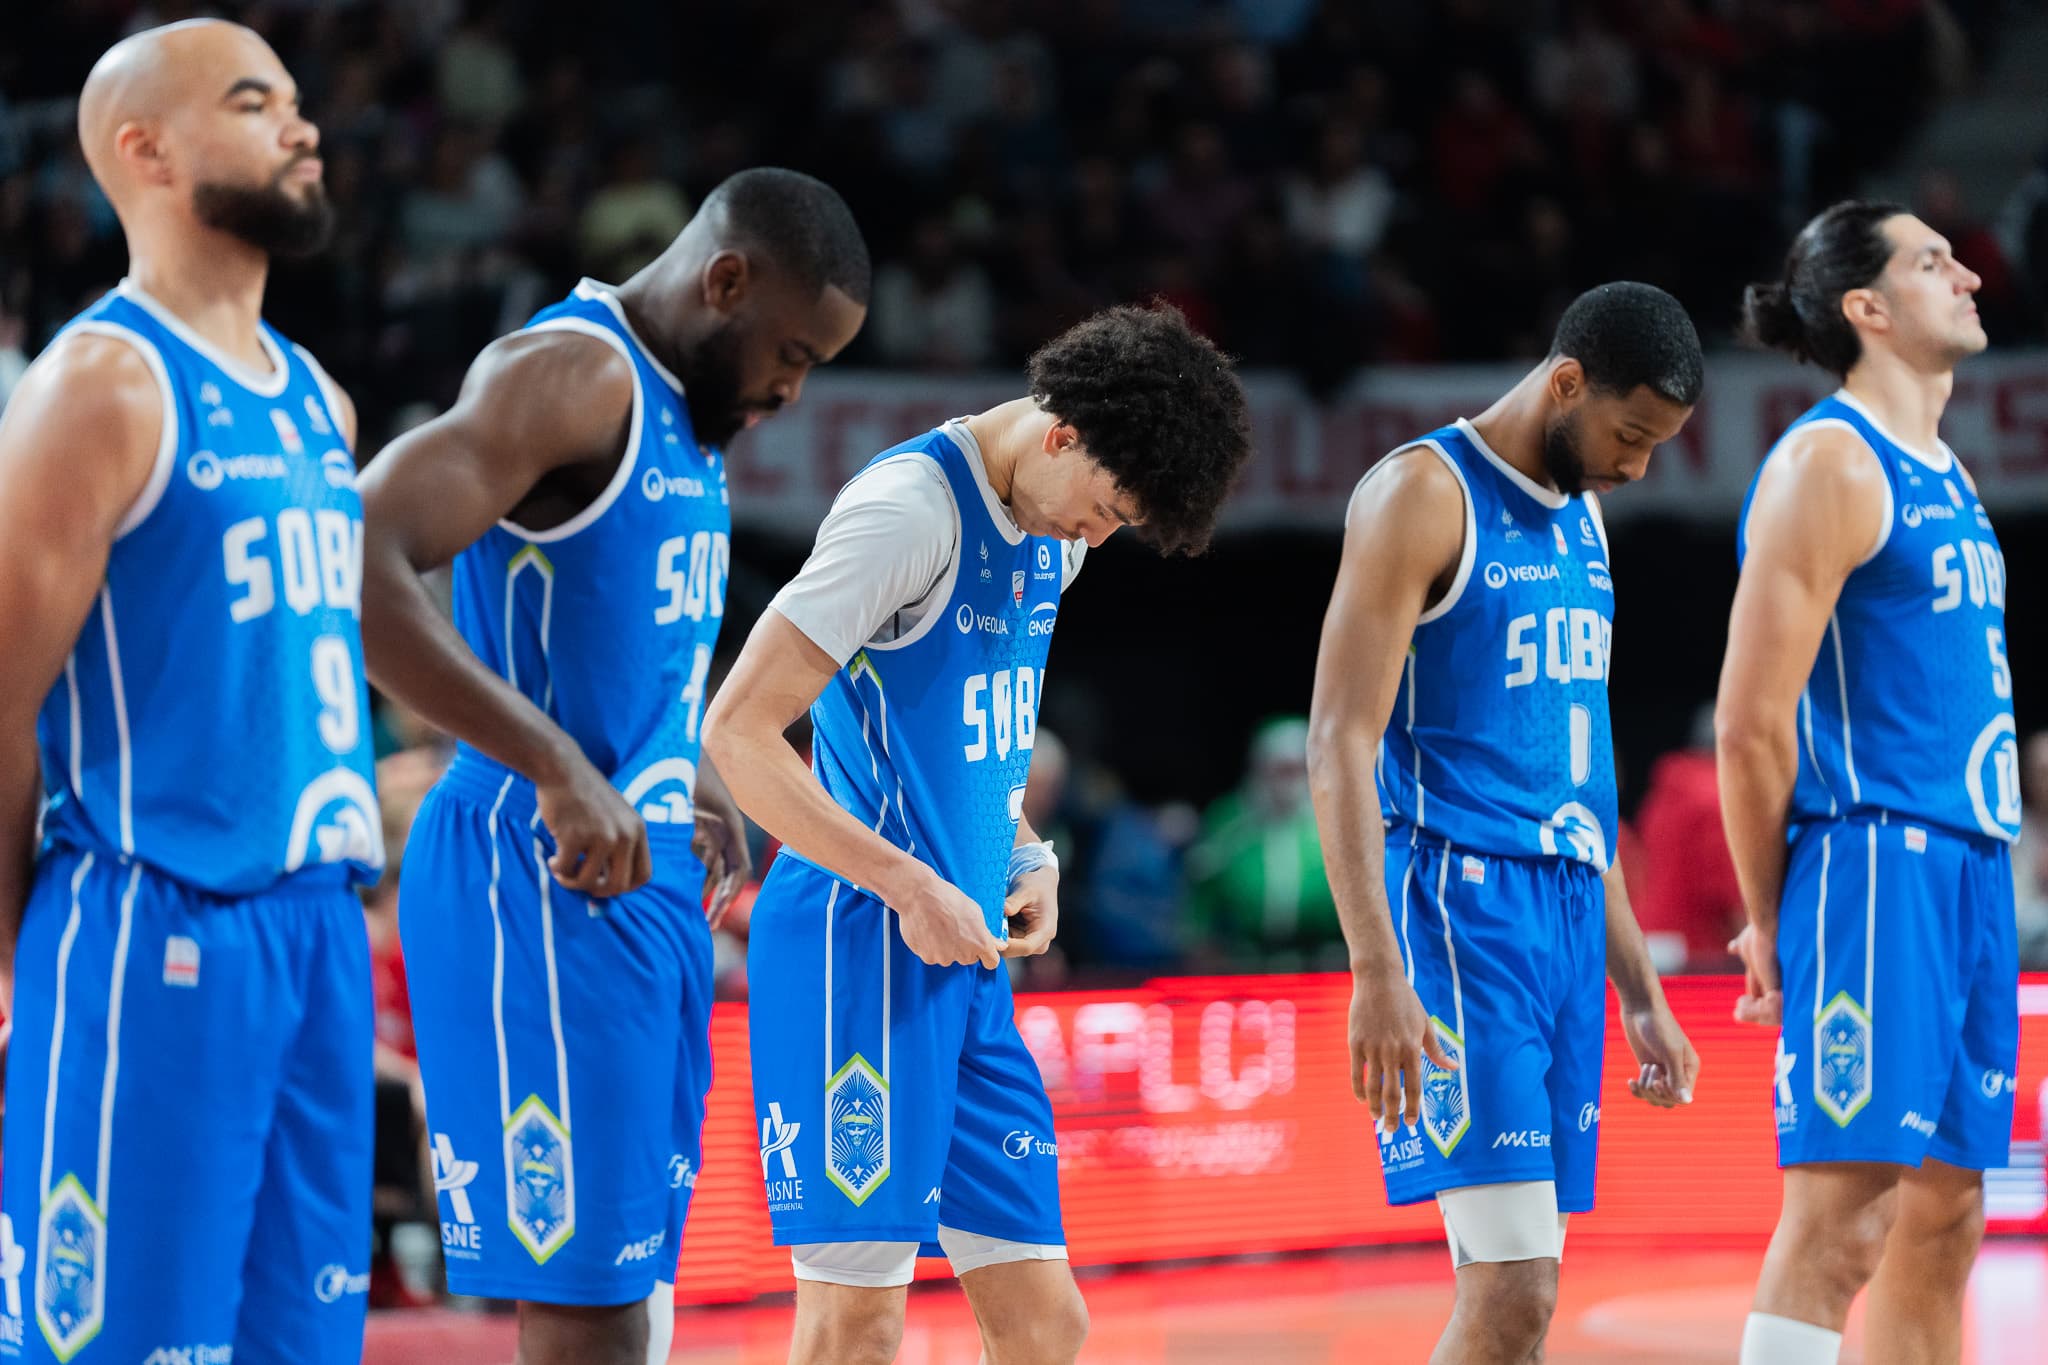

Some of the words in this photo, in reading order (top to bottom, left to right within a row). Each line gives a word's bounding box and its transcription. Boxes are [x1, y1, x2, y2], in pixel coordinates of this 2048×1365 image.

[1508, 563, 1561, 583] VEOLIA
[976, 613, 1009, 635] VEOLIA
[1985, 625, 2012, 700] 5
[310, 634, 359, 755] 9
[962, 666, 1046, 763] SQB
[1034, 1139, 1058, 1156] tran
[1530, 1130, 1552, 1148] Ene
[765, 1180, 803, 1202] AISNE
[441, 1222, 482, 1250] SNE
